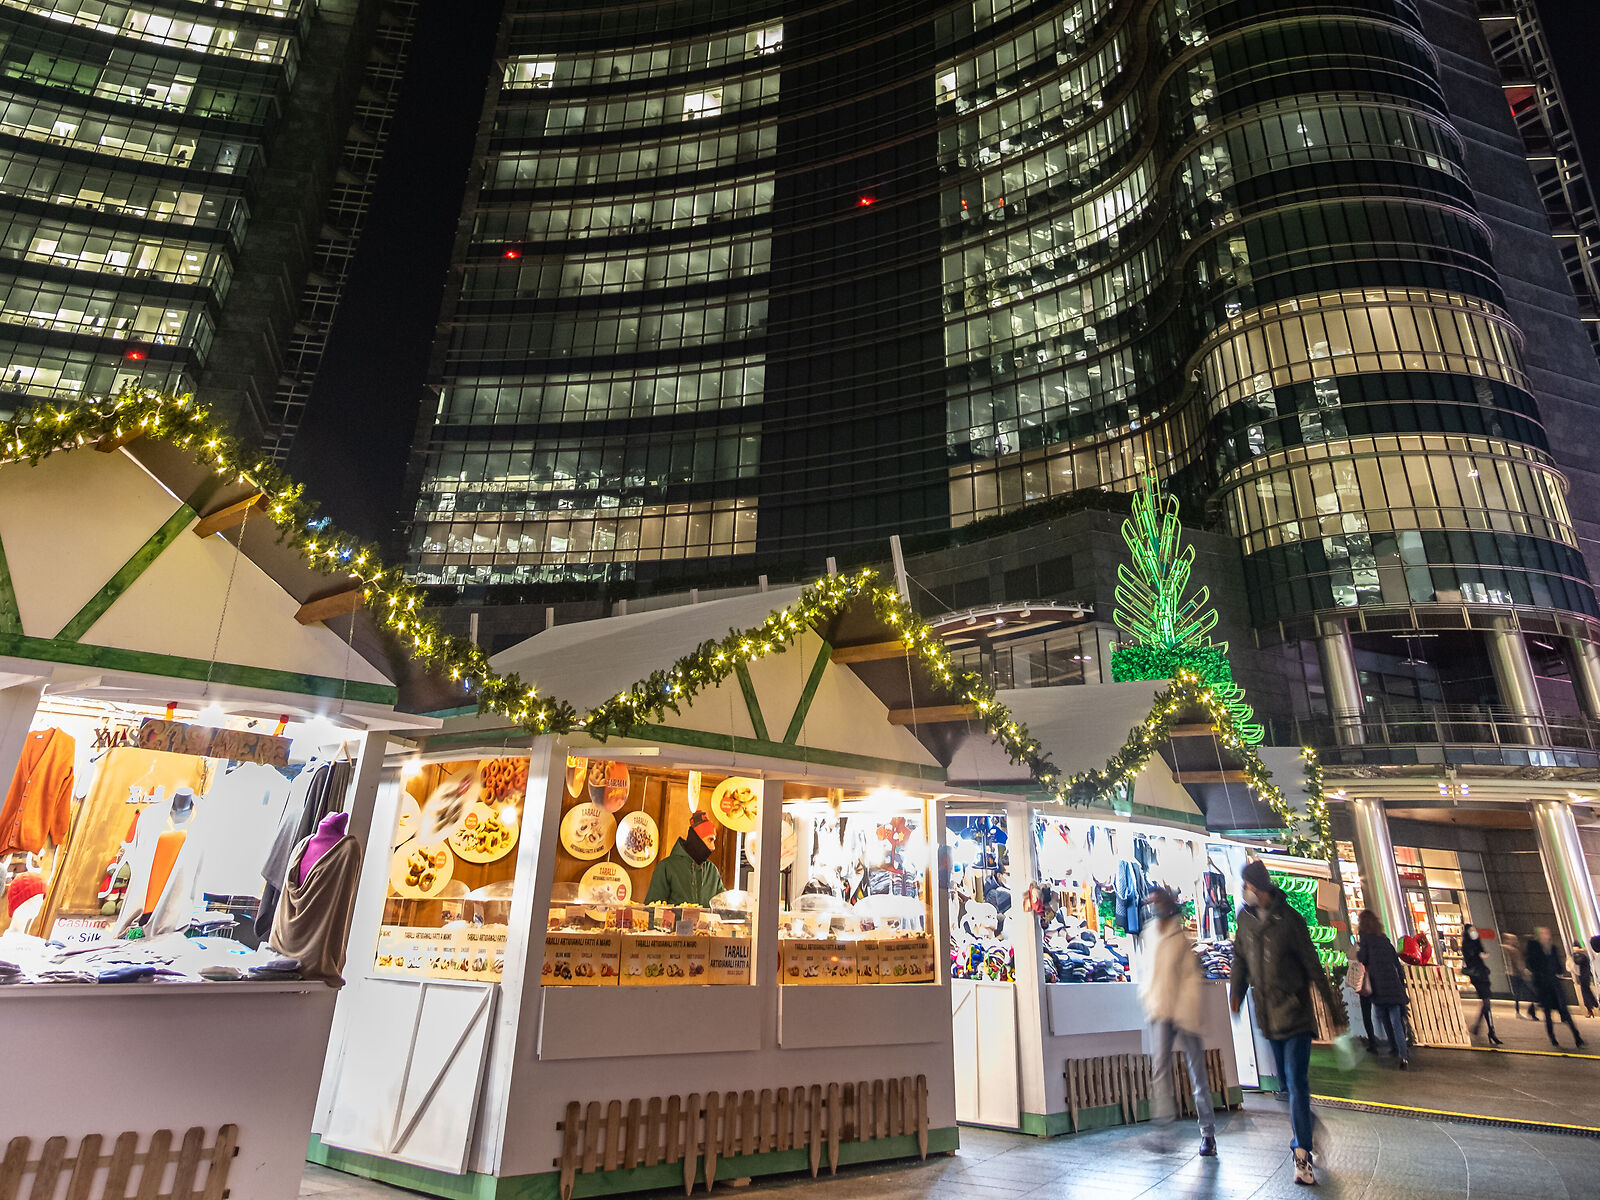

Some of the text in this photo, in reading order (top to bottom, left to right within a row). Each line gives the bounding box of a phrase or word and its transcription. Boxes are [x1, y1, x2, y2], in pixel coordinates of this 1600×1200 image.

[79, 932, 101, 943] Silk
[725, 945, 749, 958] TARALLI
[711, 960, 734, 968] ARTIGIANALI
[735, 960, 745, 968] FATTI
